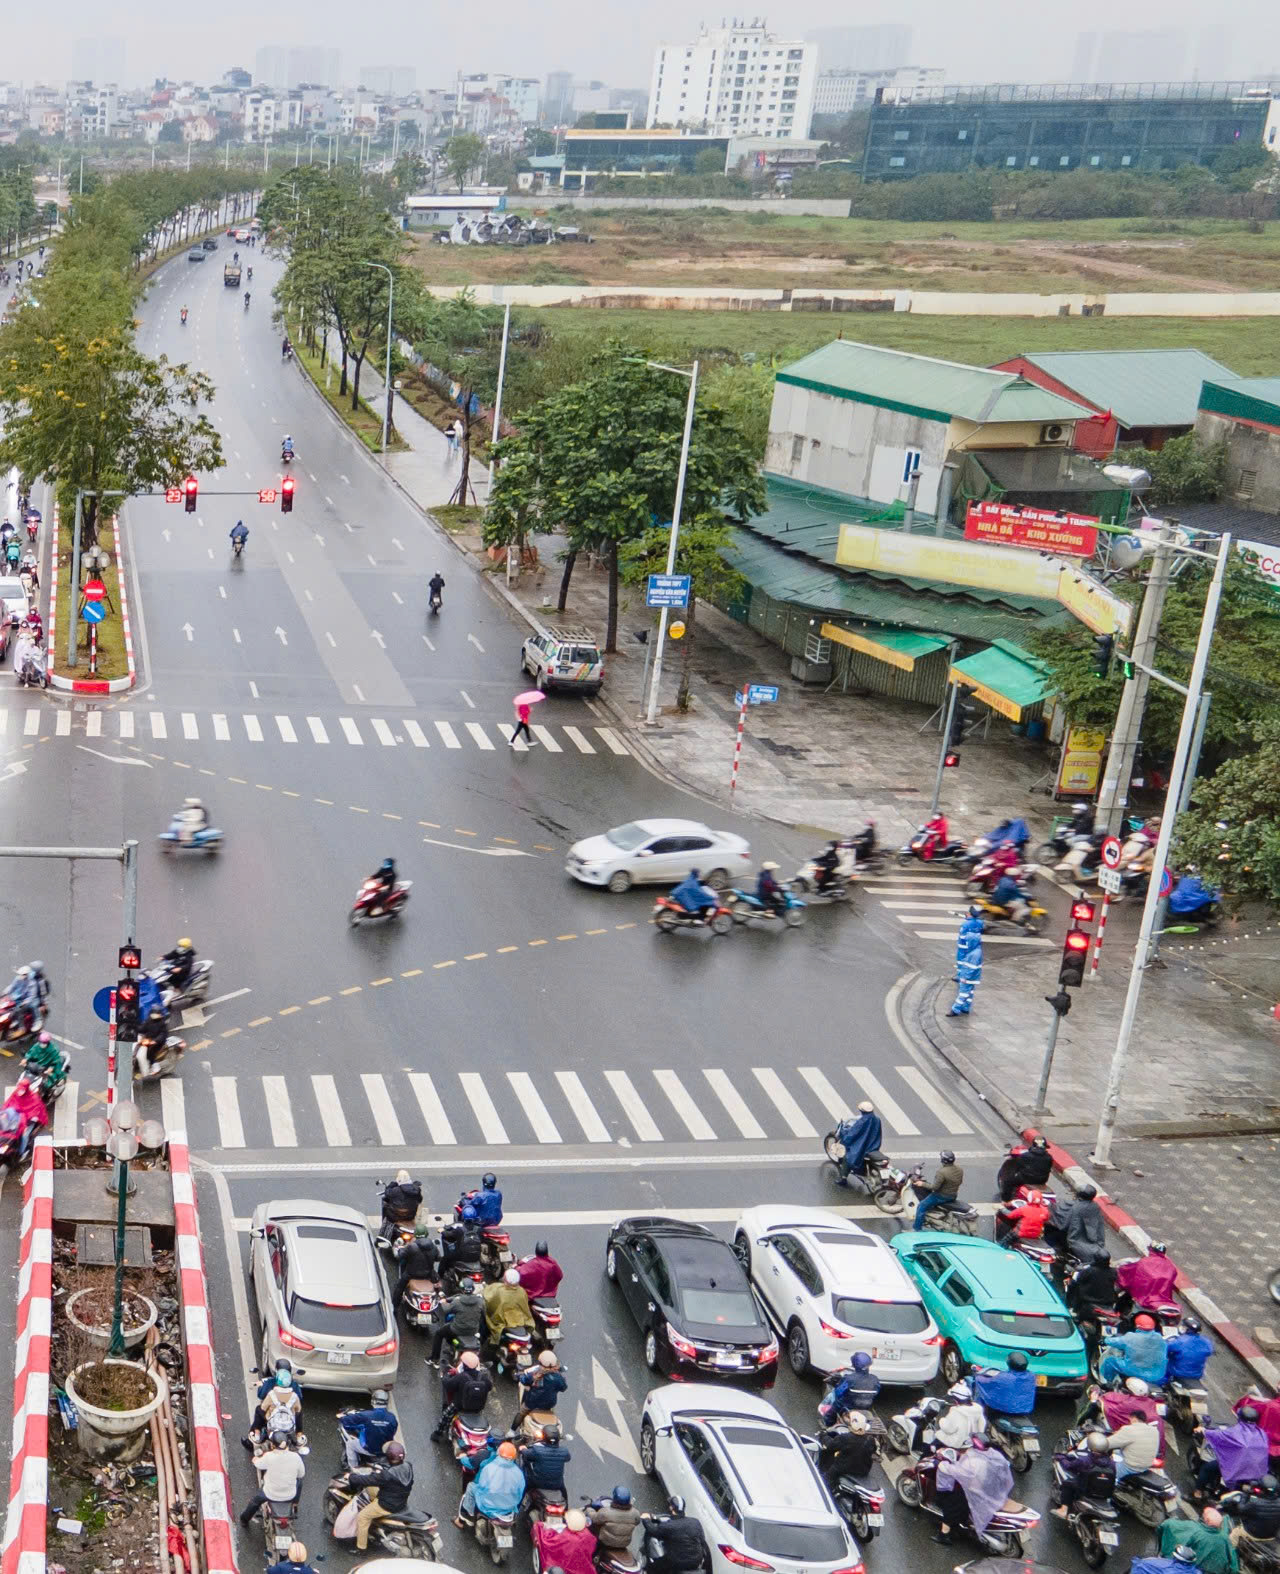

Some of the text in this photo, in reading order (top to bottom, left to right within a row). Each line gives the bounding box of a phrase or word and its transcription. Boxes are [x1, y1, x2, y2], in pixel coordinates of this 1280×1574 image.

[167, 490, 181, 502] 23
[260, 491, 276, 502] 58
[1027, 529, 1047, 541] KHO
